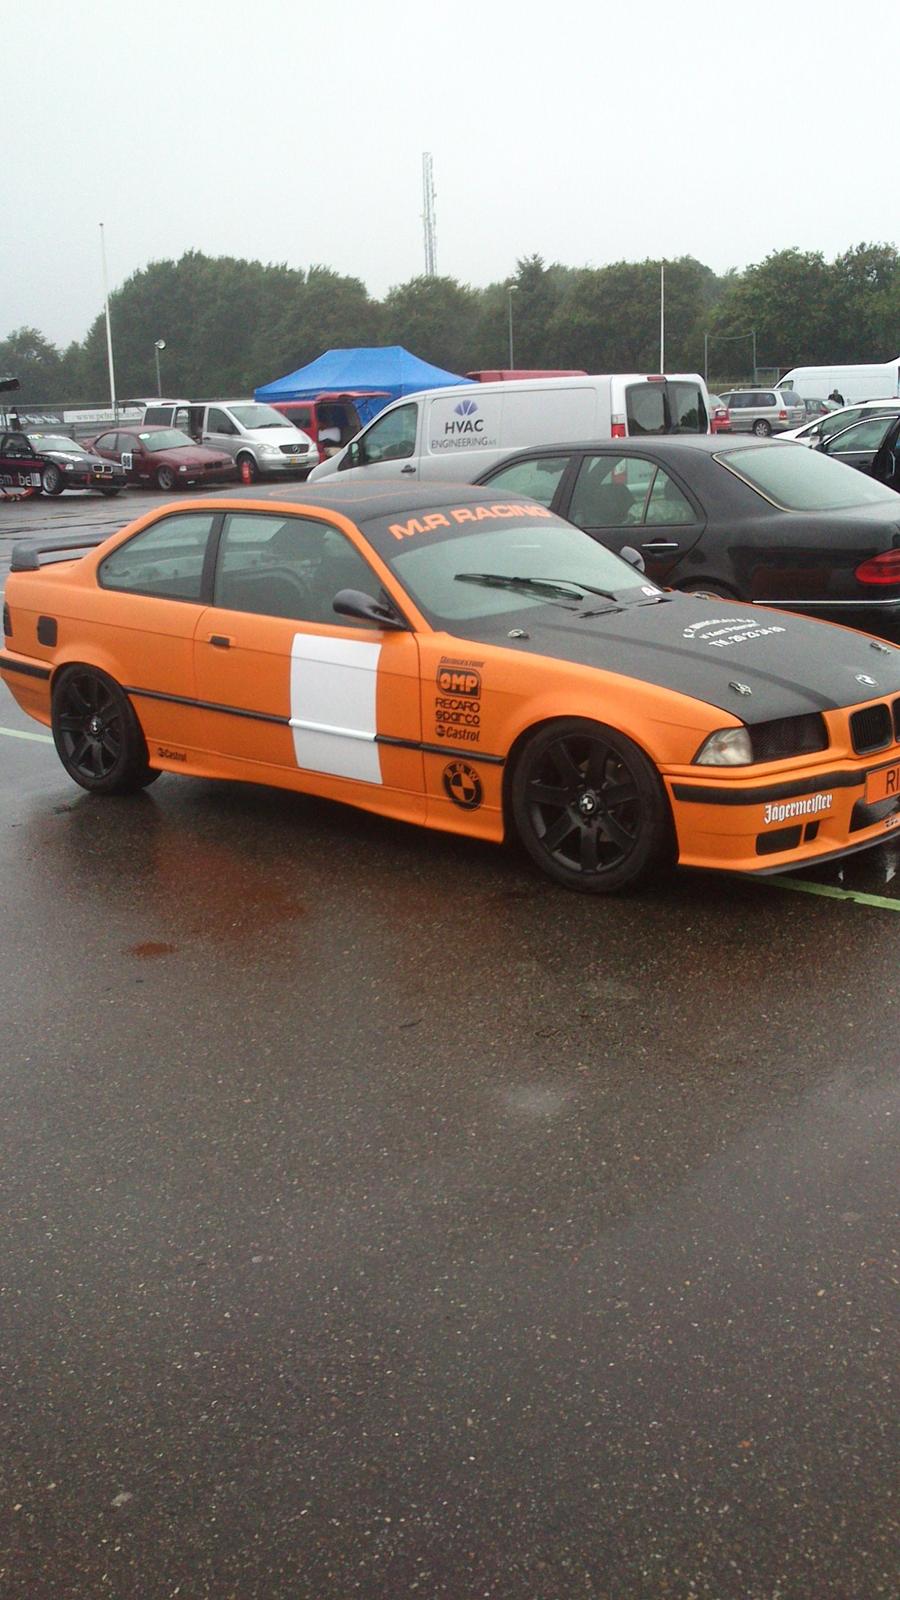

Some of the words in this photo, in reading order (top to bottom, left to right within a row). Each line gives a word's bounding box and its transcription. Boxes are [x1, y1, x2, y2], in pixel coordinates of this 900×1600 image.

[445, 419, 484, 434] HVAC
[431, 436, 488, 449] ENGINEERING
[450, 504, 552, 524] RACING
[440, 673, 478, 693] OMP
[435, 697, 480, 713] RECARO
[446, 726, 481, 742] Castrol
